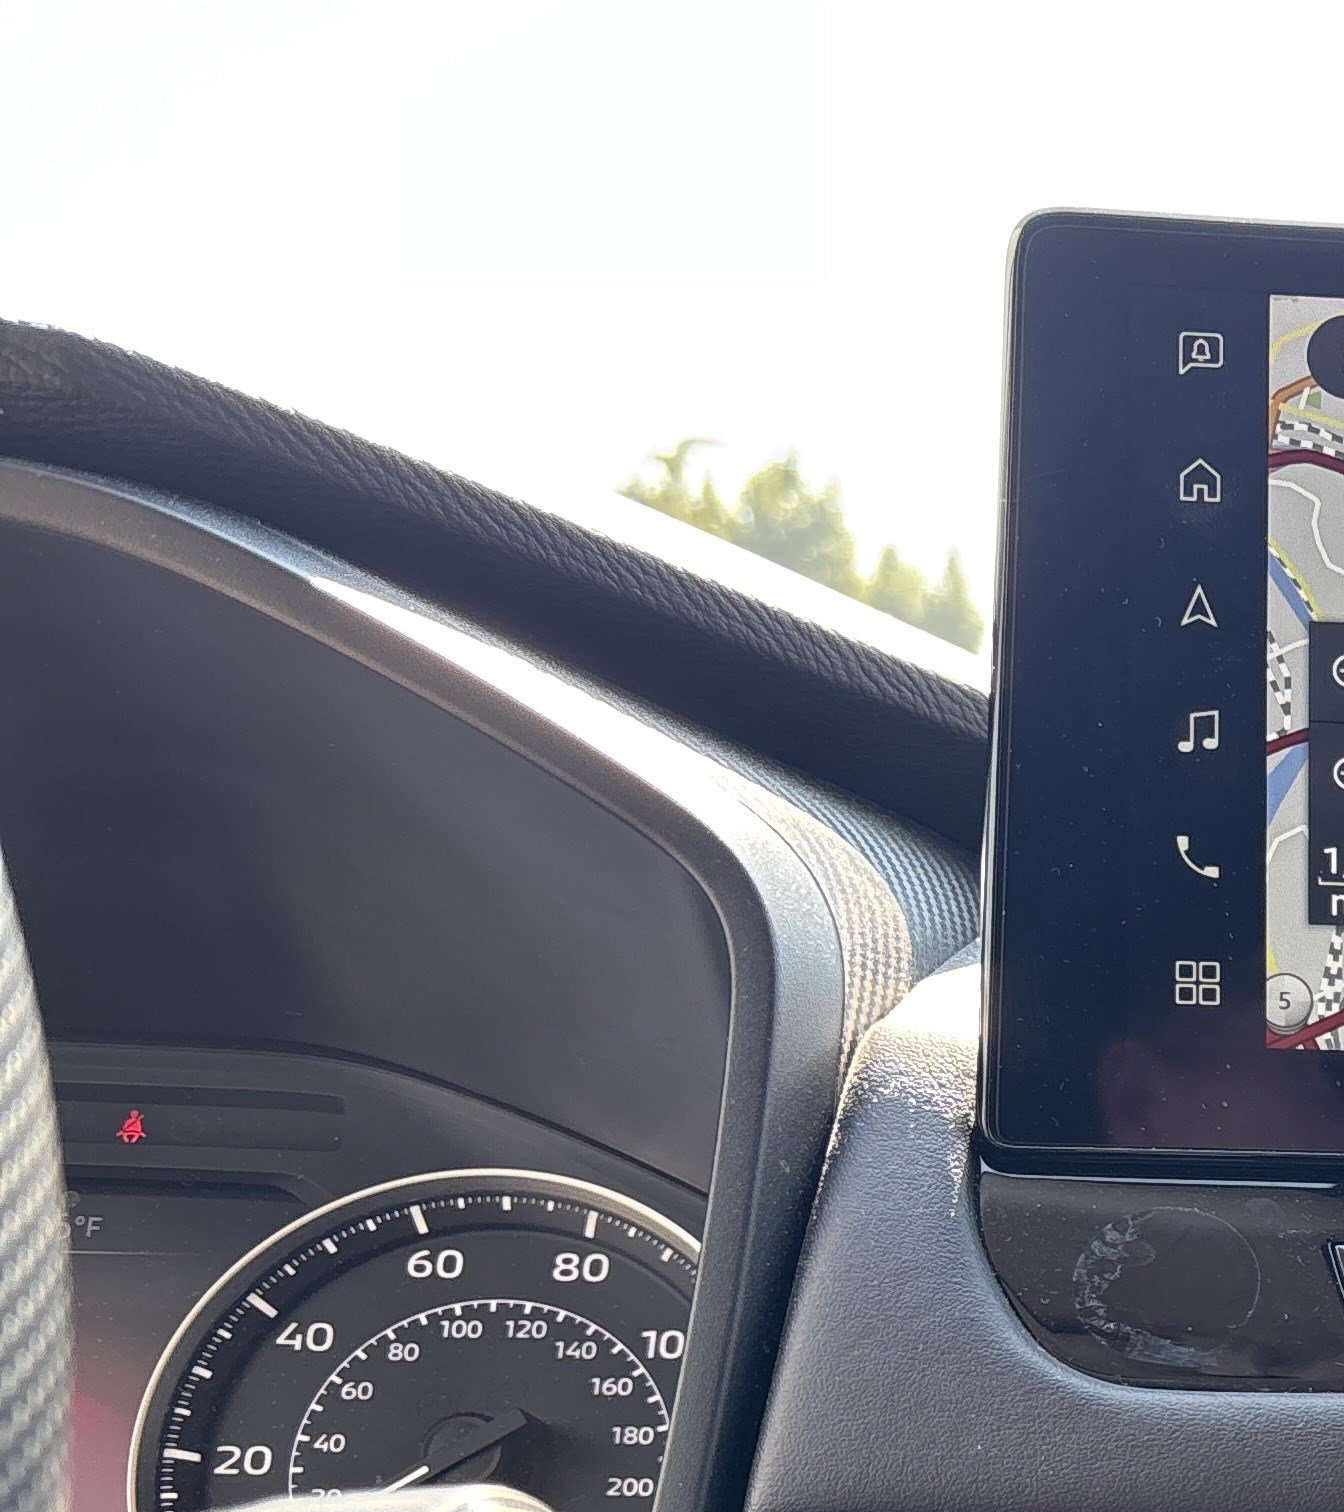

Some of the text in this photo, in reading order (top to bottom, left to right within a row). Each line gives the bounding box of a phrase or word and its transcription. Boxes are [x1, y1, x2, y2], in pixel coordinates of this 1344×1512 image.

[1279, 993, 1291, 1009] 5
[406, 1250, 465, 1279] 60
[552, 1252, 611, 1281] 80
[275, 1322, 334, 1352] 40
[440, 1319, 483, 1340] 100
[505, 1319, 547, 1340] 120
[387, 1342, 420, 1362] 80
[555, 1340, 597, 1360] 140
[641, 1330, 685, 1359] 10
[341, 1381, 374, 1401] 60
[591, 1377, 633, 1397] 160
[313, 1434, 346, 1454] 40
[612, 1426, 654, 1446] 180
[214, 1445, 273, 1475] 20
[606, 1478, 654, 1497] 200
